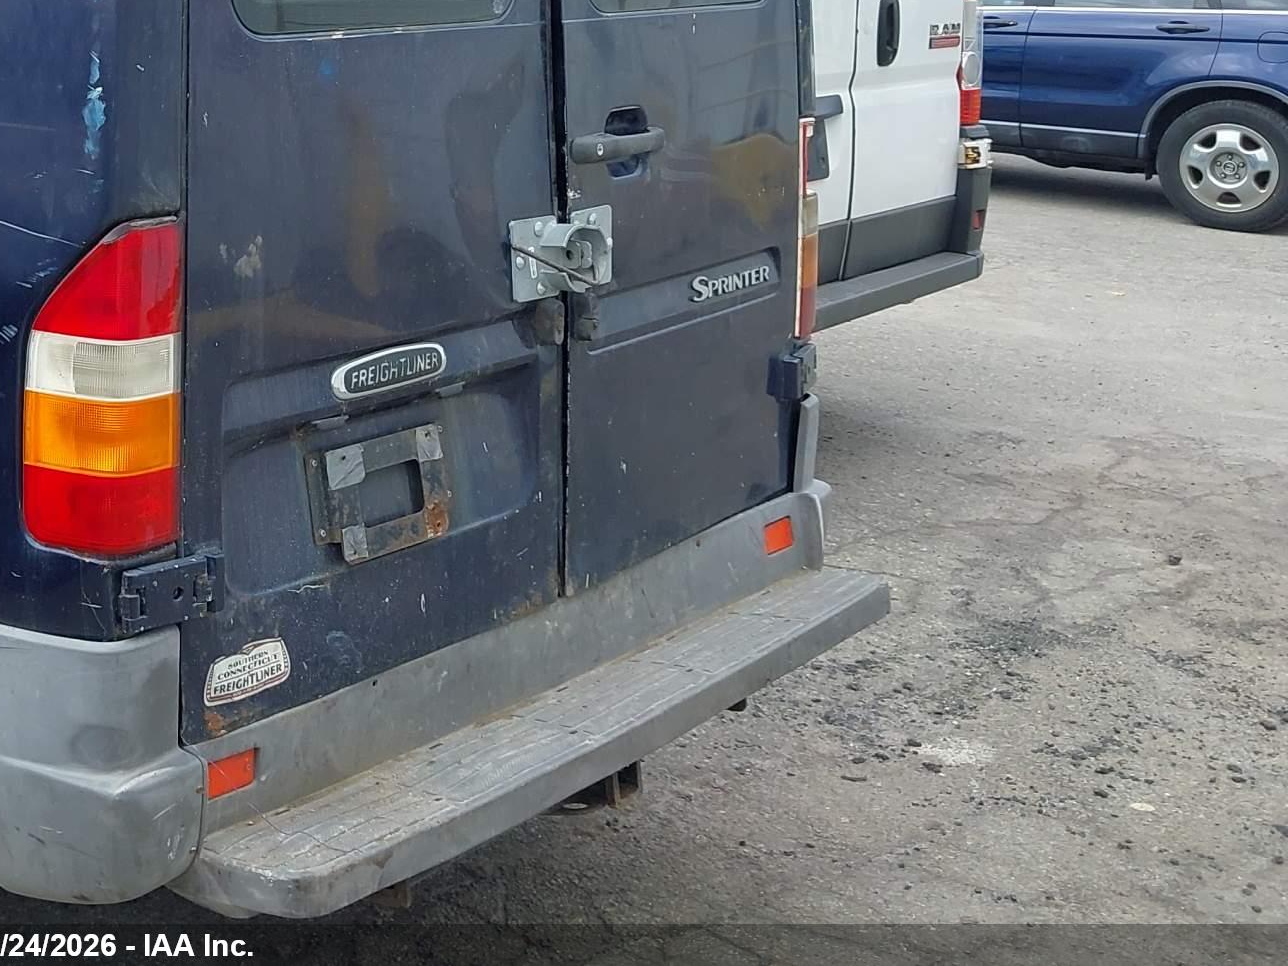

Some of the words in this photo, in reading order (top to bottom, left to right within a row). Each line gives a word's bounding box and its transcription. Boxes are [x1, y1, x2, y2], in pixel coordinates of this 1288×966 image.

[929, 22, 961, 35] RAM
[691, 265, 771, 302] SPRINTER
[350, 352, 440, 390] FREIGHTLINER
[213, 663, 283, 695] FREIGHTLINER
[217, 654, 278, 681] CONNECTICUT
